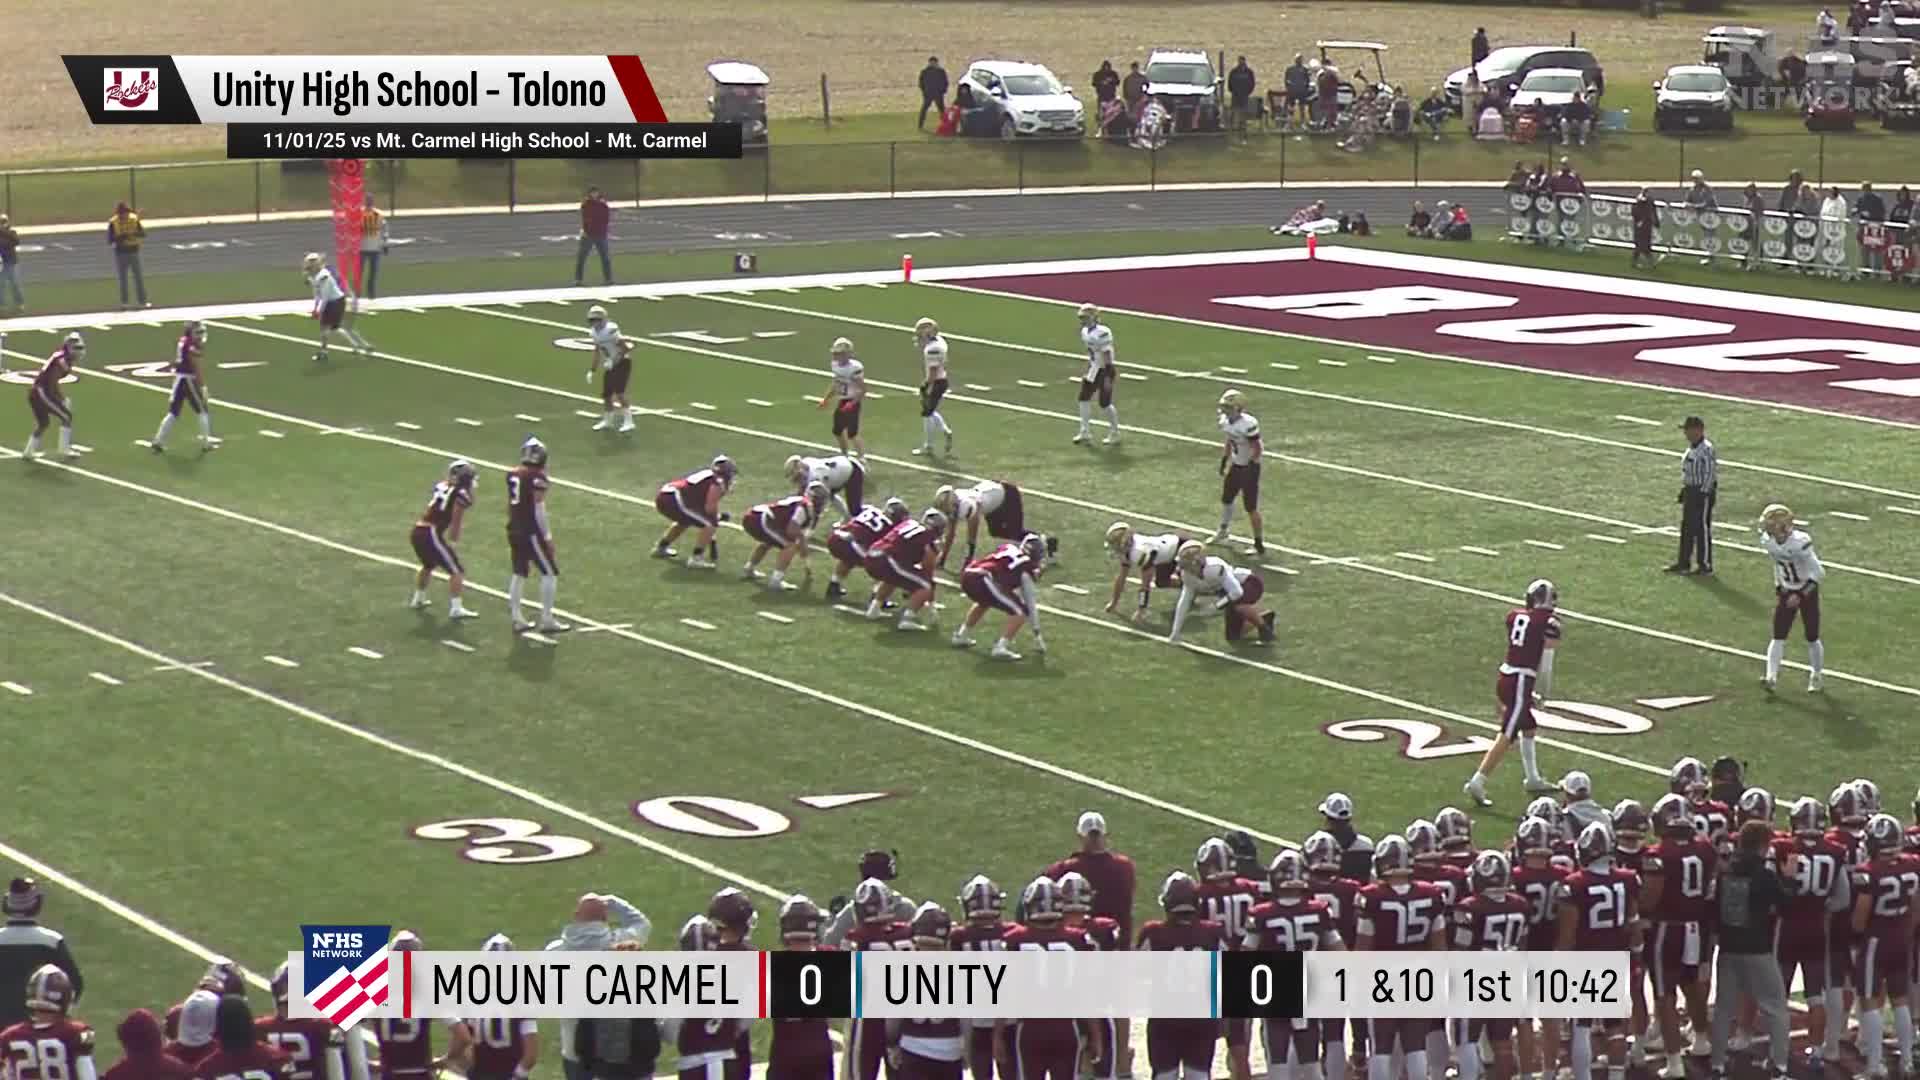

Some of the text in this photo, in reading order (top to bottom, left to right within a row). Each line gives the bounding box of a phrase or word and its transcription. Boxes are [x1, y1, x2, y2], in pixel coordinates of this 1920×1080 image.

[1210, 286, 1920, 397] ROC
[1510, 612, 1531, 647] 8
[412, 794, 793, 864] 30
[1682, 855, 1704, 897] 0
[1380, 898, 1433, 945] 75
[1587, 882, 1626, 929] 21
[1266, 914, 1320, 951] 35
[9, 1038, 69, 1080] 28
